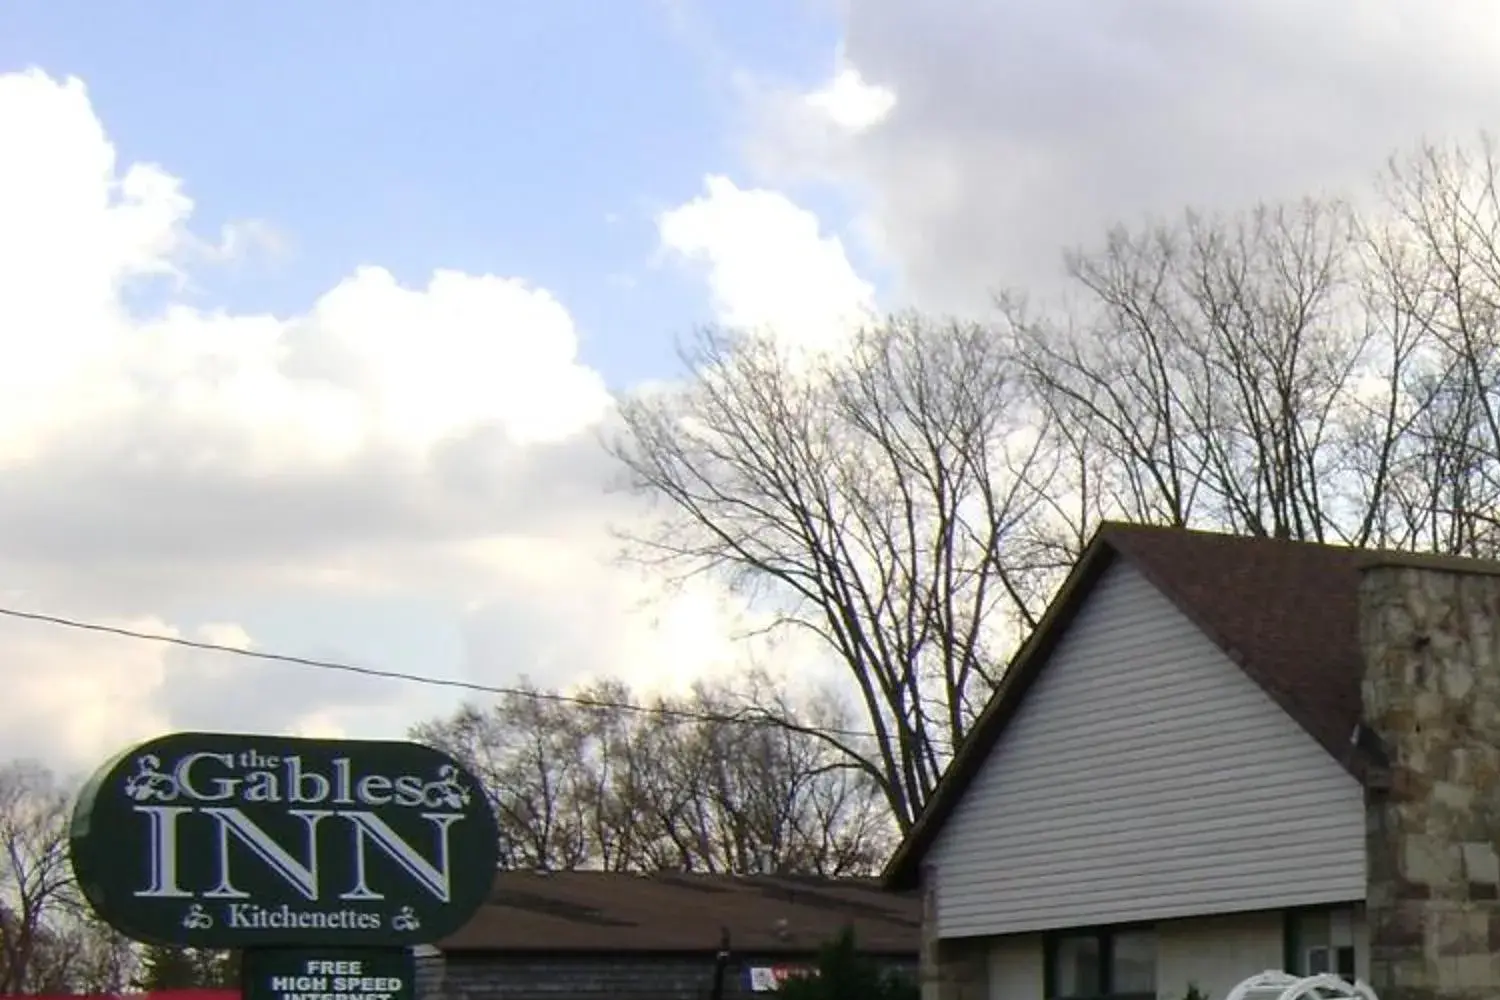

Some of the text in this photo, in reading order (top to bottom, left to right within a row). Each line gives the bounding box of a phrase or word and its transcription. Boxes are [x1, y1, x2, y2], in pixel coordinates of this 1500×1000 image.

[239, 749, 281, 769] the
[174, 751, 424, 806] Gables
[133, 805, 466, 901] INN
[228, 904, 382, 930] Kitchenettes
[306, 961, 363, 975] FREE
[272, 976, 403, 991] HIGH SPEED
